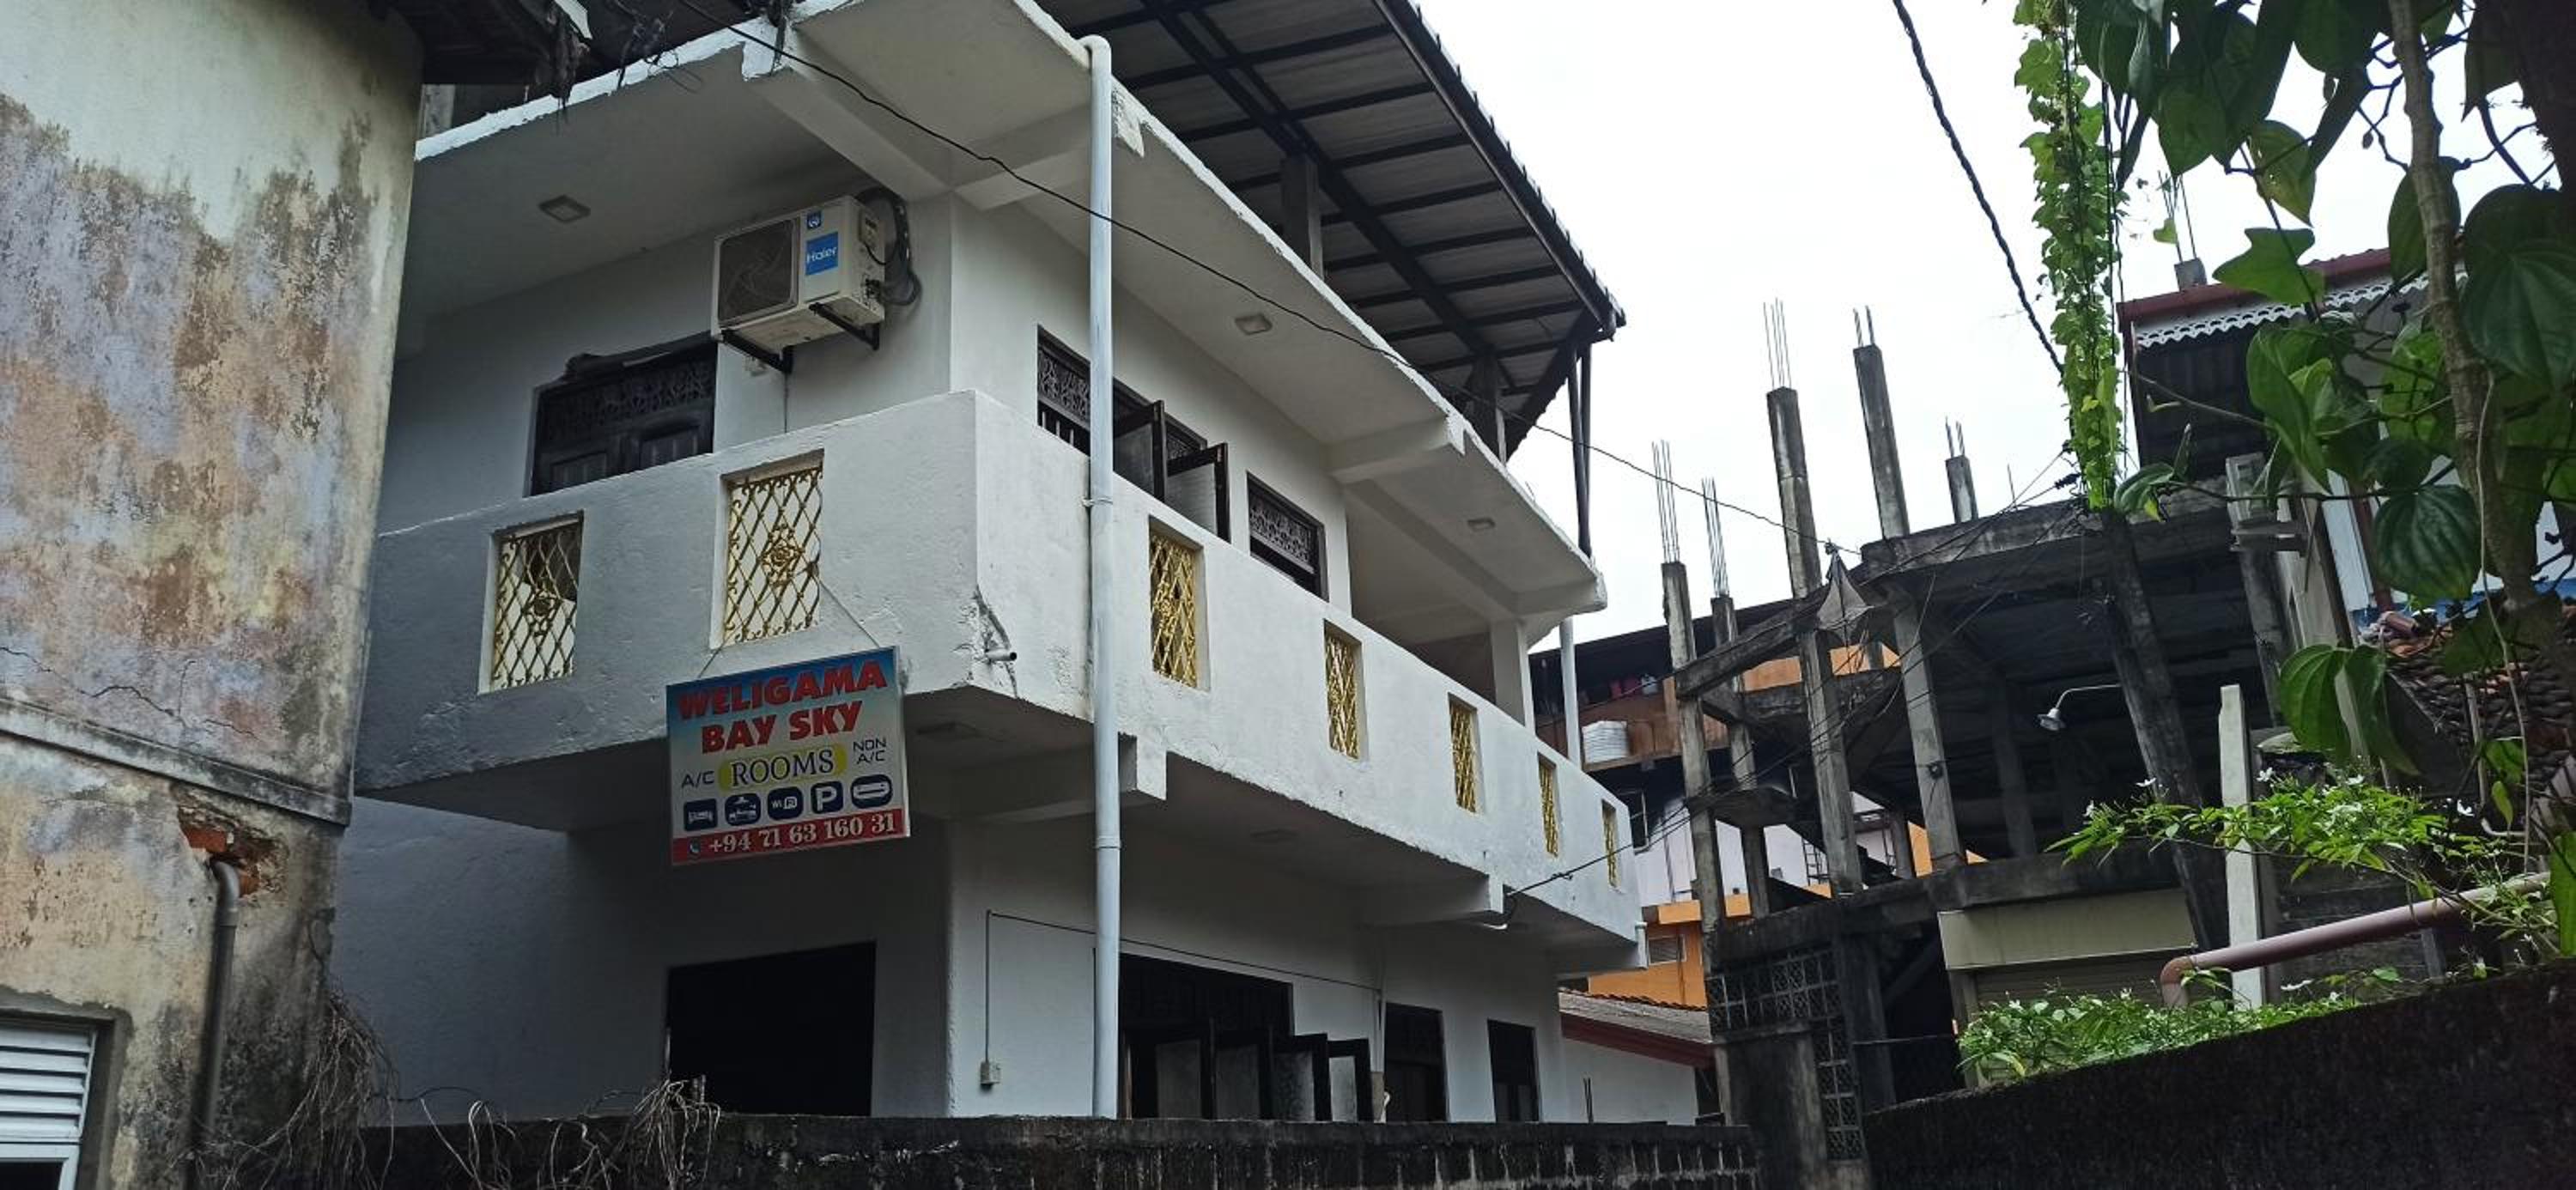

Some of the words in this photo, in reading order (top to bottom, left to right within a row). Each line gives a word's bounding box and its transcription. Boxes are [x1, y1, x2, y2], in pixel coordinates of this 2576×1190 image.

[677, 660, 888, 719] WELIGAMA
[701, 713, 776, 754] BAY
[788, 700, 862, 741] SKY
[853, 738, 886, 750] NON
[680, 770, 714, 788] A/C
[731, 749, 835, 786] ROOMS
[856, 750, 885, 764] A/C
[708, 833, 752, 853] +94
[758, 827, 781, 847] 71
[788, 823, 817, 843] 63
[823, 818, 864, 839] 160
[871, 814, 895, 833] 31
